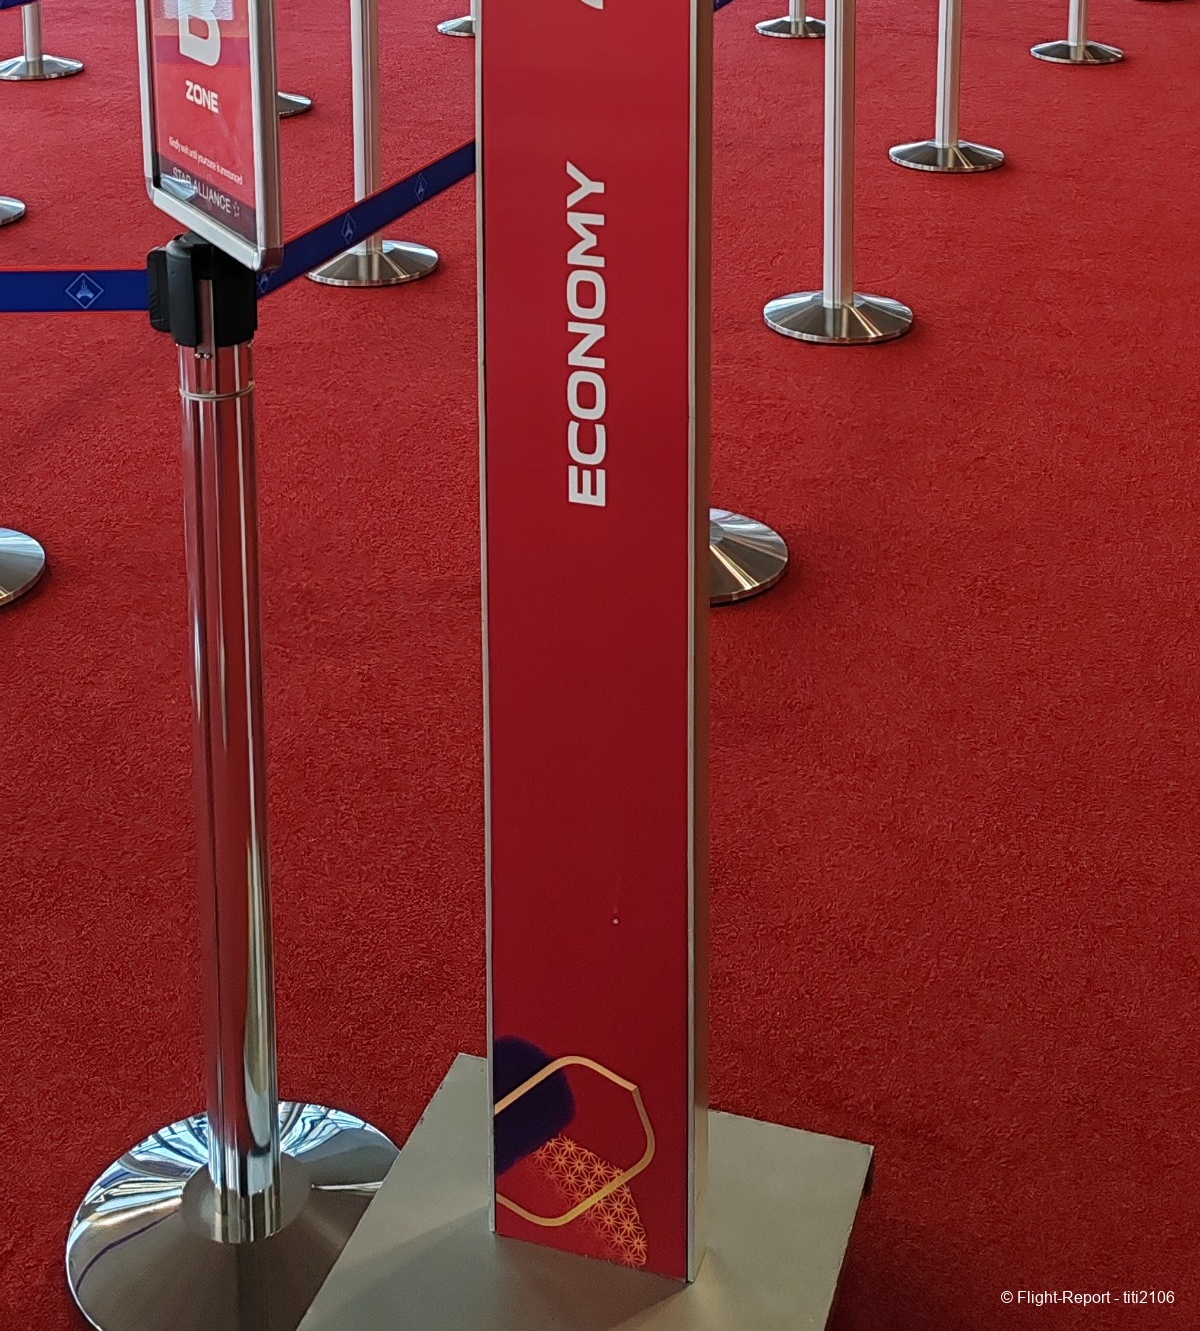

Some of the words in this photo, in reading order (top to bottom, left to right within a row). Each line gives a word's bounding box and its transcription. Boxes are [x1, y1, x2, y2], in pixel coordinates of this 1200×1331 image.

[185, 79, 219, 114] ZONE
[172, 167, 193, 190] STAR
[193, 178, 231, 213] ALLIANCE
[566, 160, 606, 507] ECONOMY
